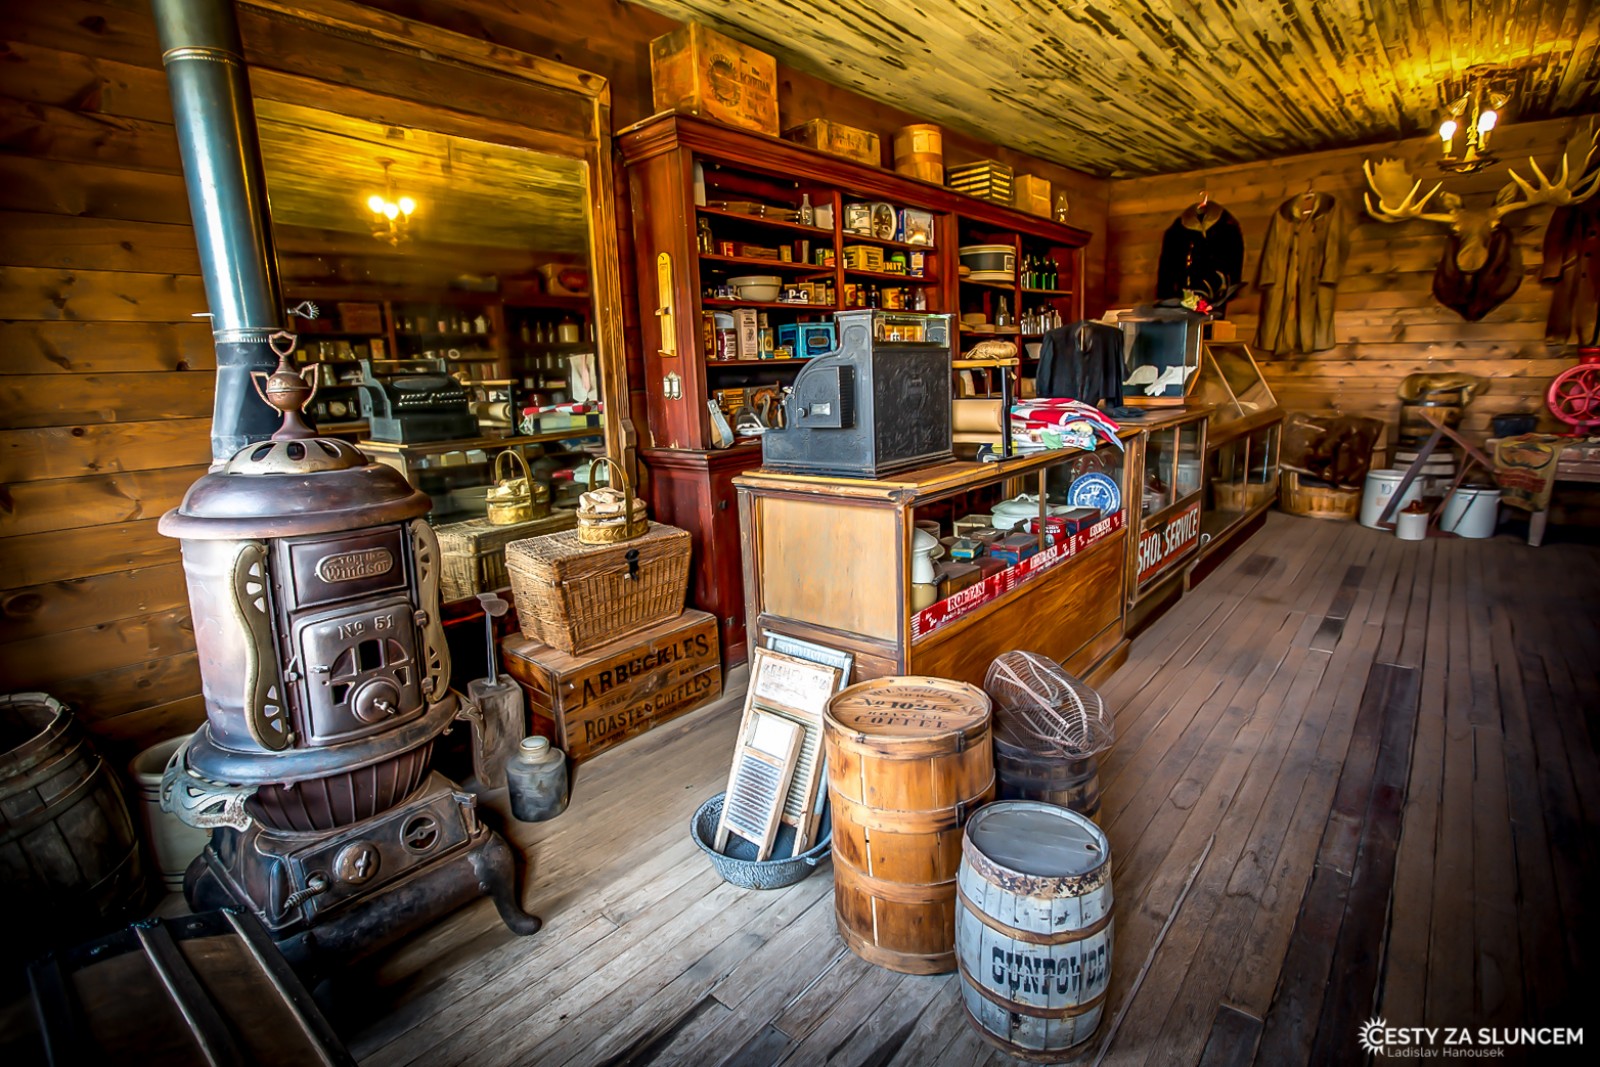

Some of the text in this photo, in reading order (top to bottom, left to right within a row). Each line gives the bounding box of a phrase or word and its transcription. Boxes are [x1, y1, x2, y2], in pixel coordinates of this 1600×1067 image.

[1164, 508, 1198, 557] SERVICE
[323, 559, 389, 580] Windsor
[949, 582, 984, 610] ROI-TAN
[373, 614, 395, 631] 51
[583, 633, 709, 708] ARBUCKLES
[584, 702, 653, 743] ROASTED
[655, 672, 711, 710] COFFEES
[854, 716, 949, 728] COFFEE
[992, 939, 1110, 995] GUNPOWDE
